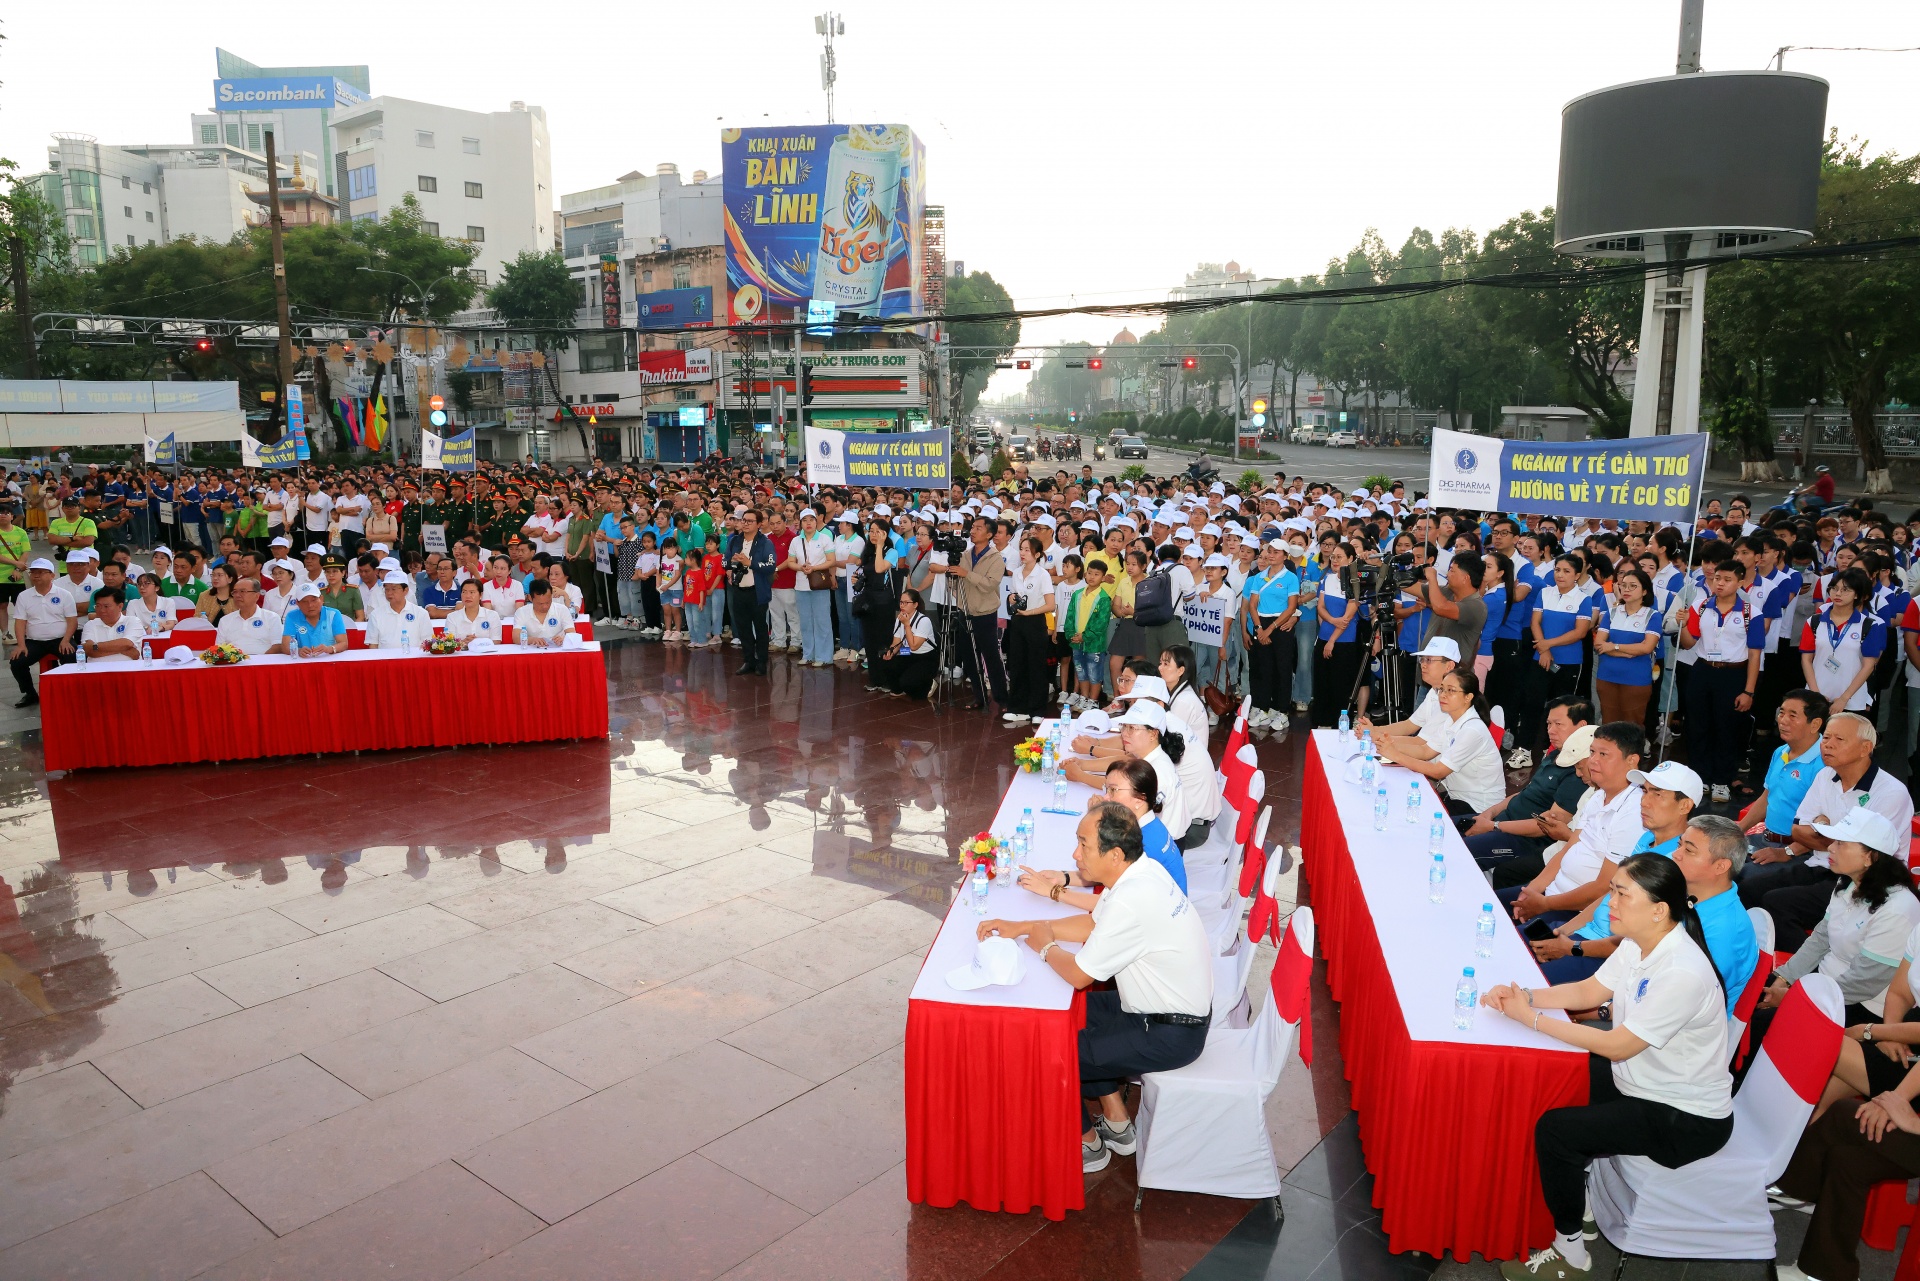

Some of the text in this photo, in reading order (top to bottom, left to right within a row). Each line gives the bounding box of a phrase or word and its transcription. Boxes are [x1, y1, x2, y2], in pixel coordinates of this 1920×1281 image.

[219, 83, 326, 102] Sacombank
[749, 134, 816, 153] KHAI XUÂN
[745, 148, 797, 186] BẢN
[753, 187, 818, 225] LĨNH
[821, 223, 890, 275] Tiger
[825, 280, 868, 295] CRYSTAL
[651, 304, 674, 314] BOSCH
[702, 365, 710, 374] MỸ
[840, 356, 879, 366] TRUNG
[572, 403, 615, 416] NAM ĐÔ
[849, 439, 943, 457] NGÀNH Y TẾ CẦN THƠ
[849, 459, 946, 478] HƯỚNG VỀ Y TẾ CƠ SỞ
[1512, 451, 1690, 476] NGÀNH Y TẾ CẦN THƠ
[1439, 480, 1491, 490] DHG PHARMA
[1509, 478, 1691, 507] HƯỚNG VỀ Y TẾ CƠ SỞ
[1183, 603, 1221, 621] HỐI Y TẾ
[1188, 620, 1222, 635] PHÒNG
